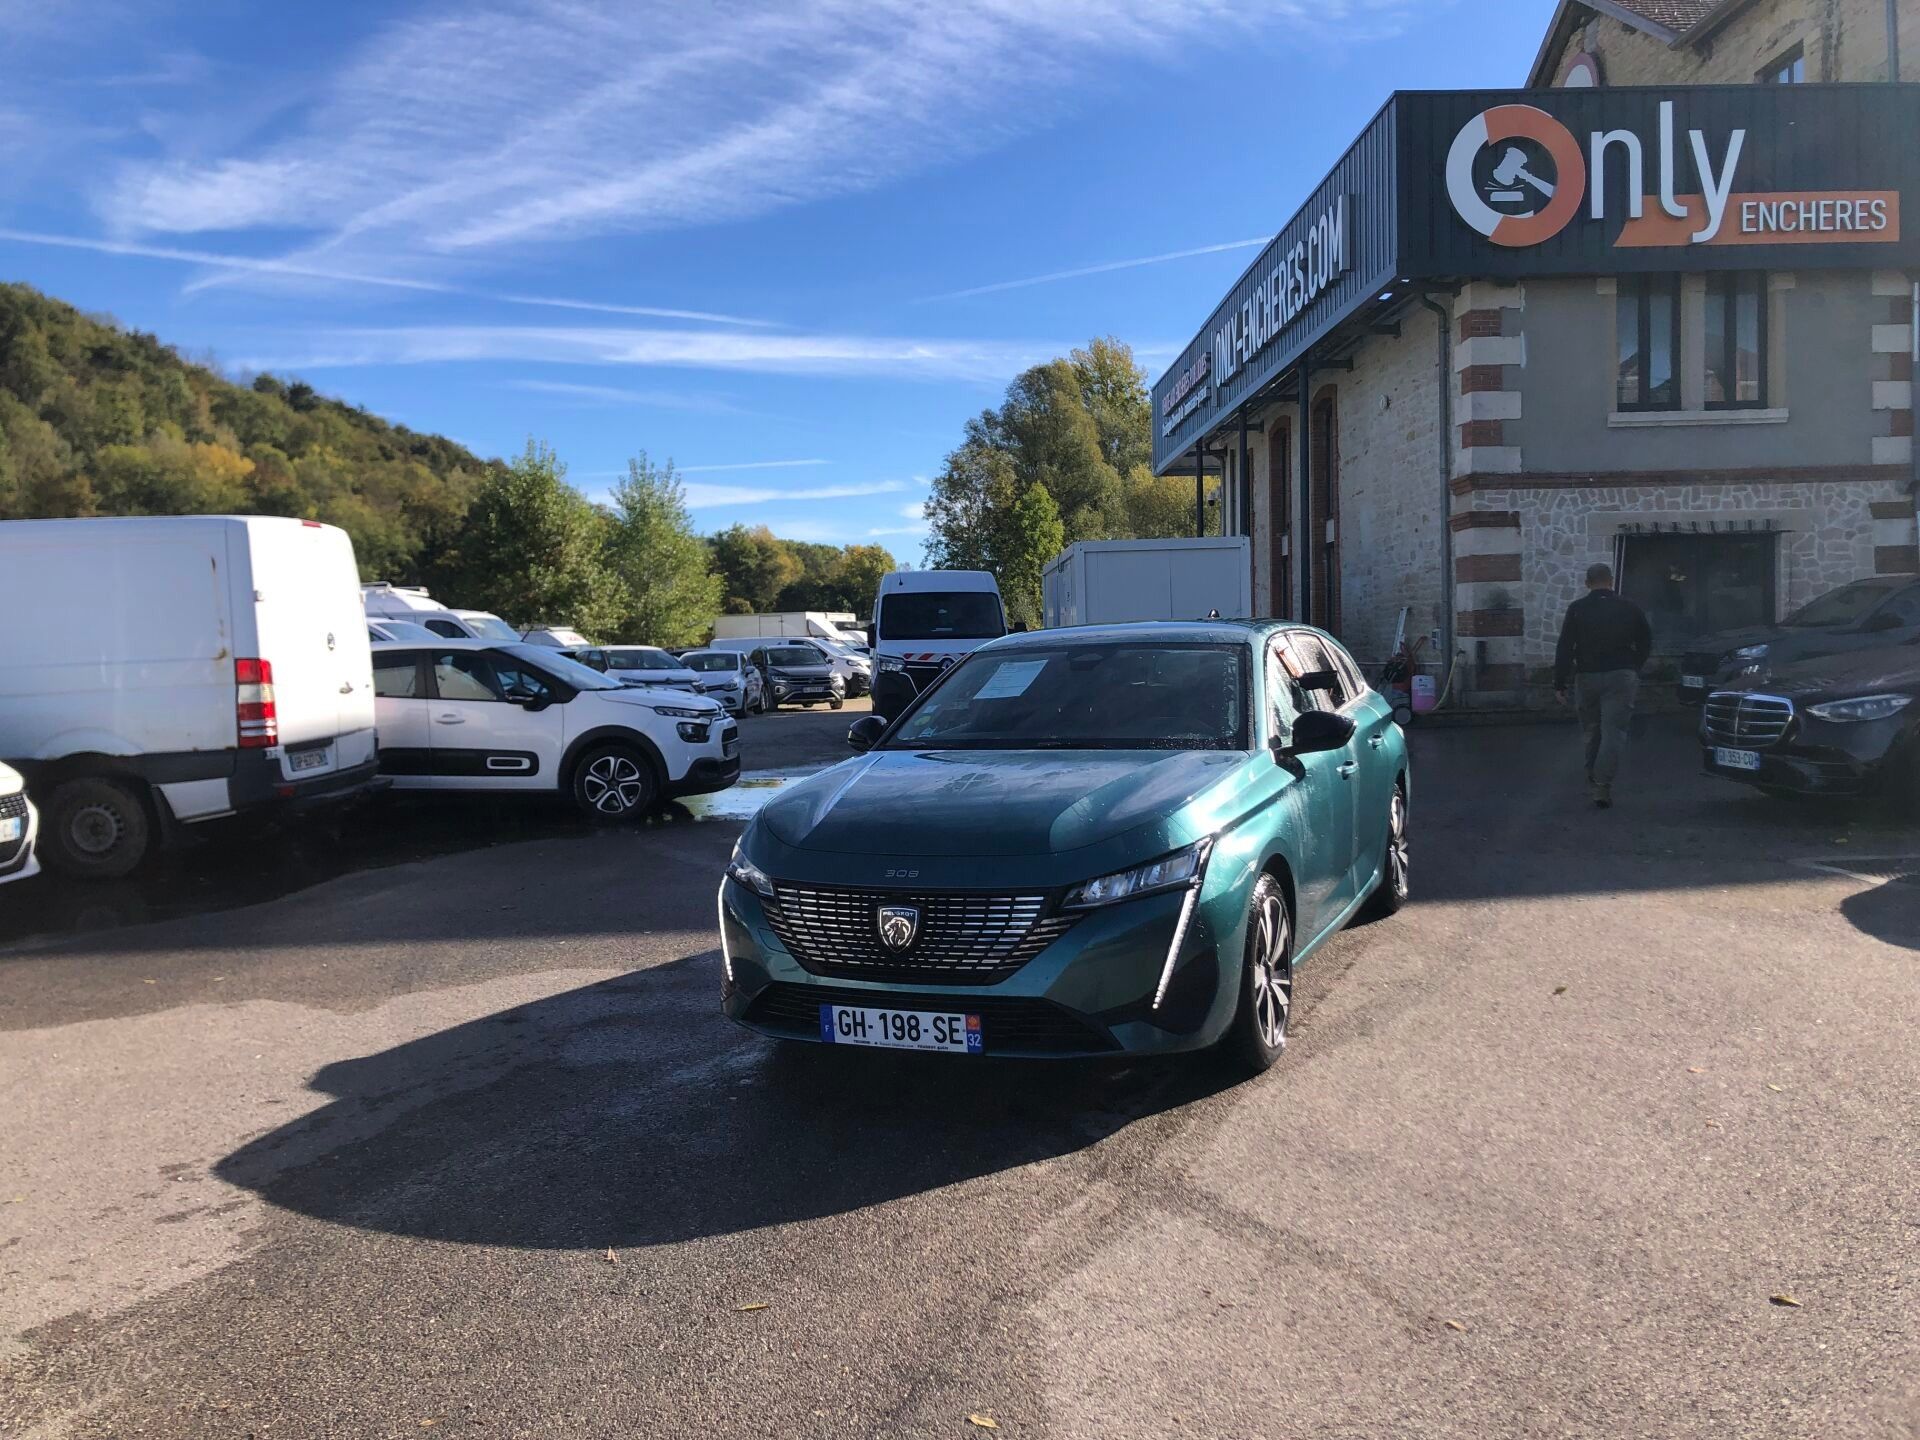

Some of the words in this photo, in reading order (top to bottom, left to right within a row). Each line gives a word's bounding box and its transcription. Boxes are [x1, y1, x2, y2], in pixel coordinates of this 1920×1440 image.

[1446, 100, 1746, 247] Only
[1741, 199, 1887, 233] ENCHERES
[1215, 194, 1343, 389] ONLY-ENCHERES.COM
[885, 869, 920, 878] 308
[825, 1024, 830, 1033] F
[838, 1009, 964, 1045] GH-198-SE
[967, 1033, 982, 1047] 32
